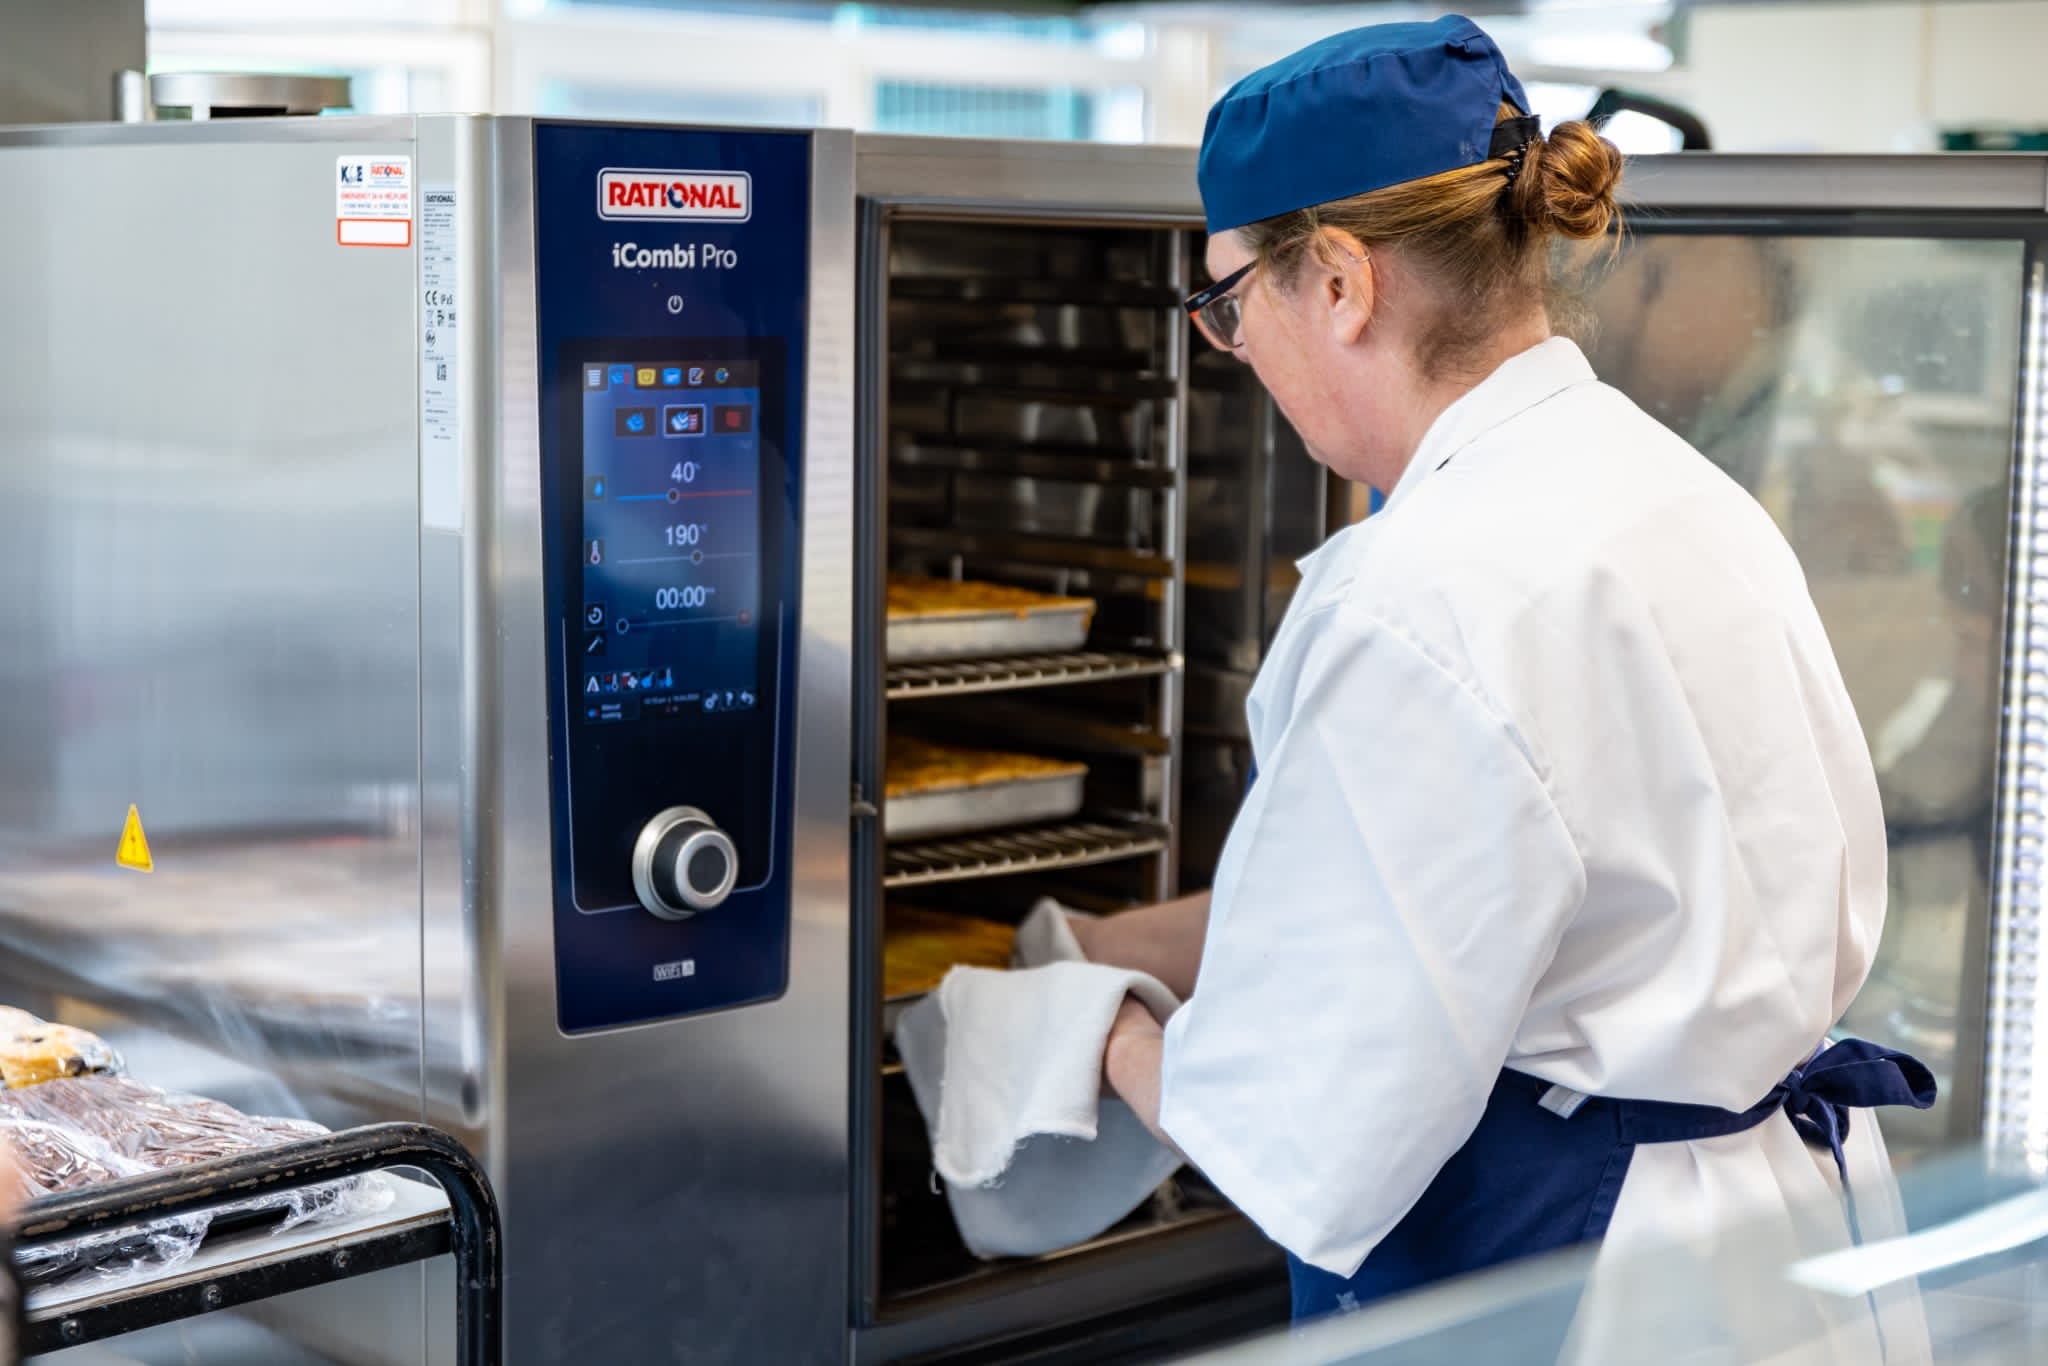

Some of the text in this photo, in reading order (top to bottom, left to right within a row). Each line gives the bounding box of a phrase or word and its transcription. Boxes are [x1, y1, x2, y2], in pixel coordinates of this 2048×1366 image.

[609, 181, 742, 209] RATIONAL
[612, 242, 738, 269] iCombi Pro
